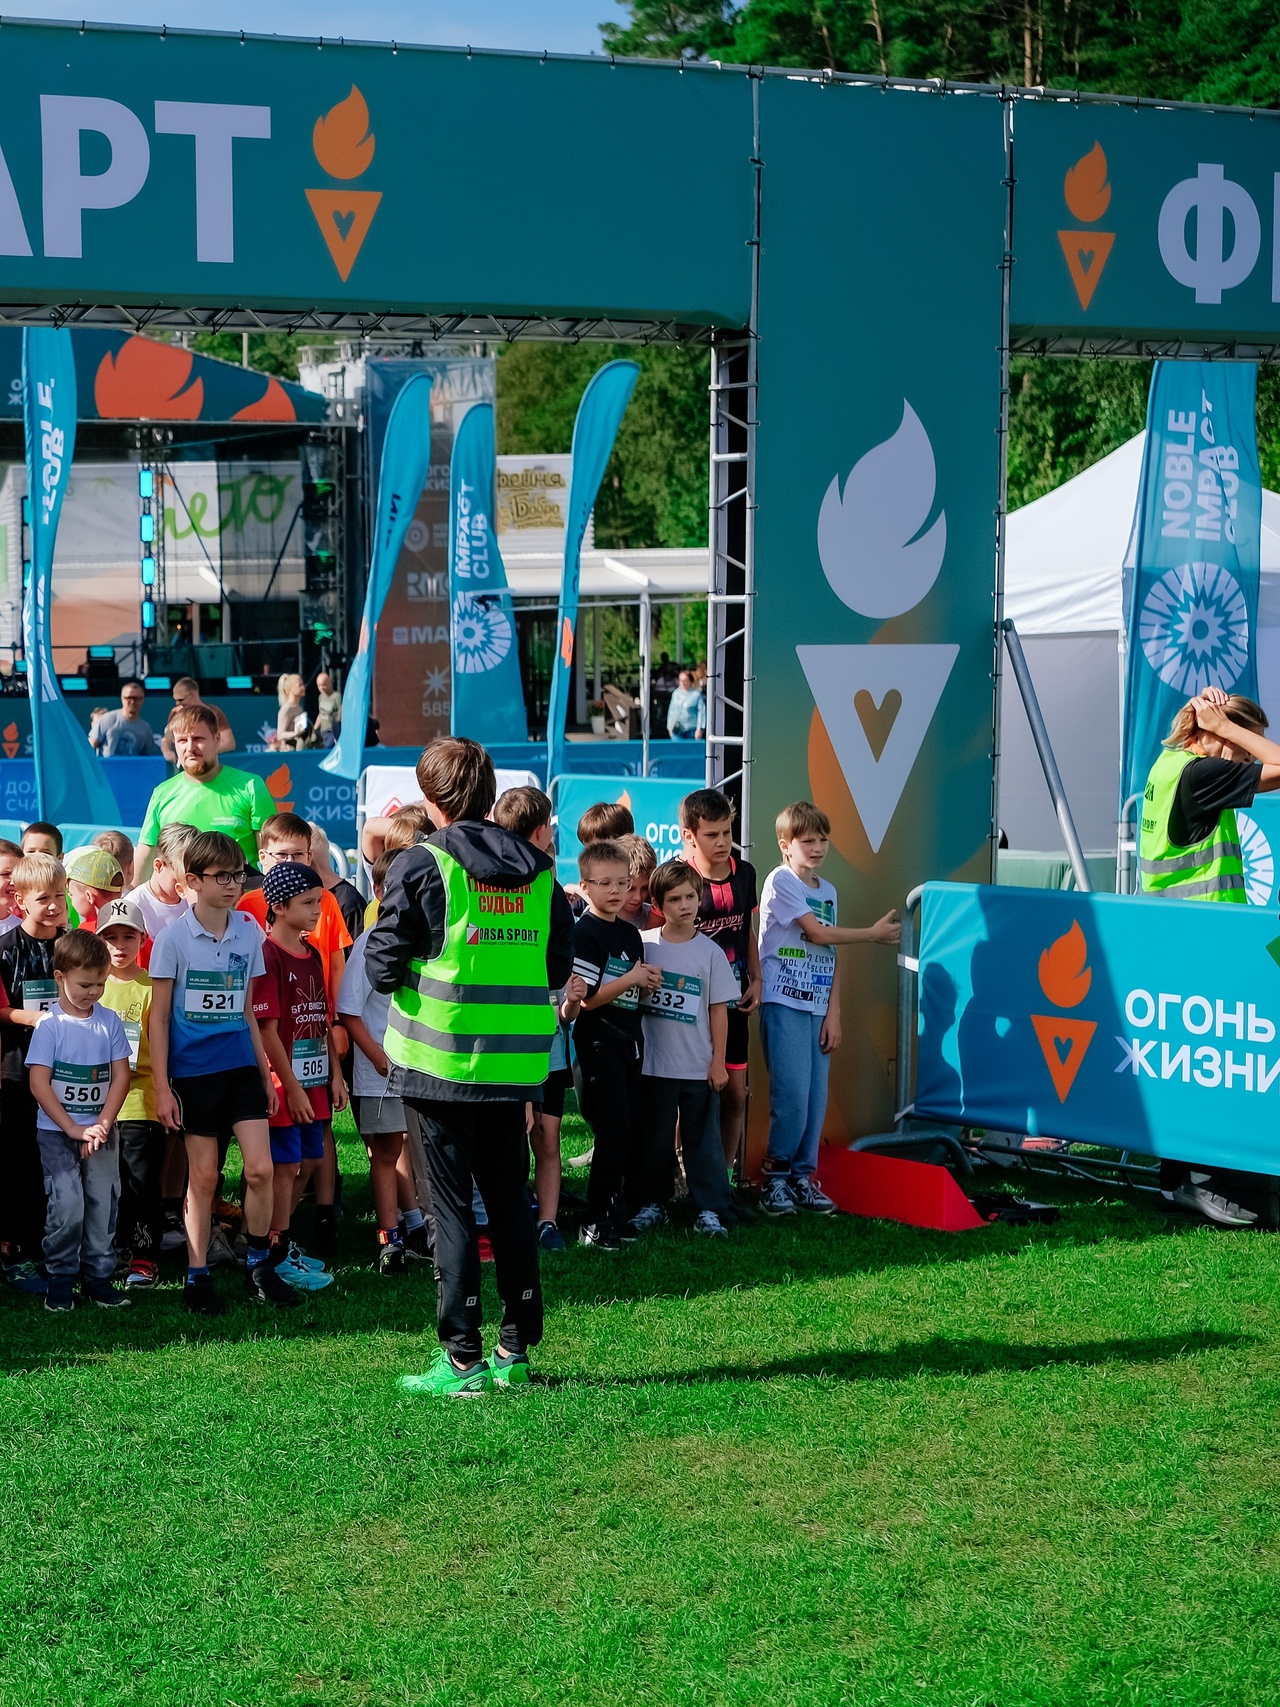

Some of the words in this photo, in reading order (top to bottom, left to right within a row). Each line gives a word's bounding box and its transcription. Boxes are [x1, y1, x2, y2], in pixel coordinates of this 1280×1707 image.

[1161, 409, 1197, 539] NOBLE
[1195, 388, 1223, 542] IMPACT
[455, 478, 475, 579] IMPACT
[473, 512, 490, 579] CLUB
[309, 786, 358, 801] ОГО
[304, 804, 356, 821] ЖИЗ
[645, 822, 680, 845] ОГО
[479, 895, 524, 916] СУДЬЯ
[480, 928, 505, 941] ORSA
[506, 928, 539, 942] SPORT
[202, 994, 234, 1010] 521
[253, 1003, 269, 1012] 585
[651, 990, 685, 1010] 532
[1125, 988, 1277, 1043] ОГОНЬ
[303, 1060, 323, 1077] 505
[1113, 1035, 1280, 1095] ЖИЗНИ
[64, 1086, 101, 1102] 550
